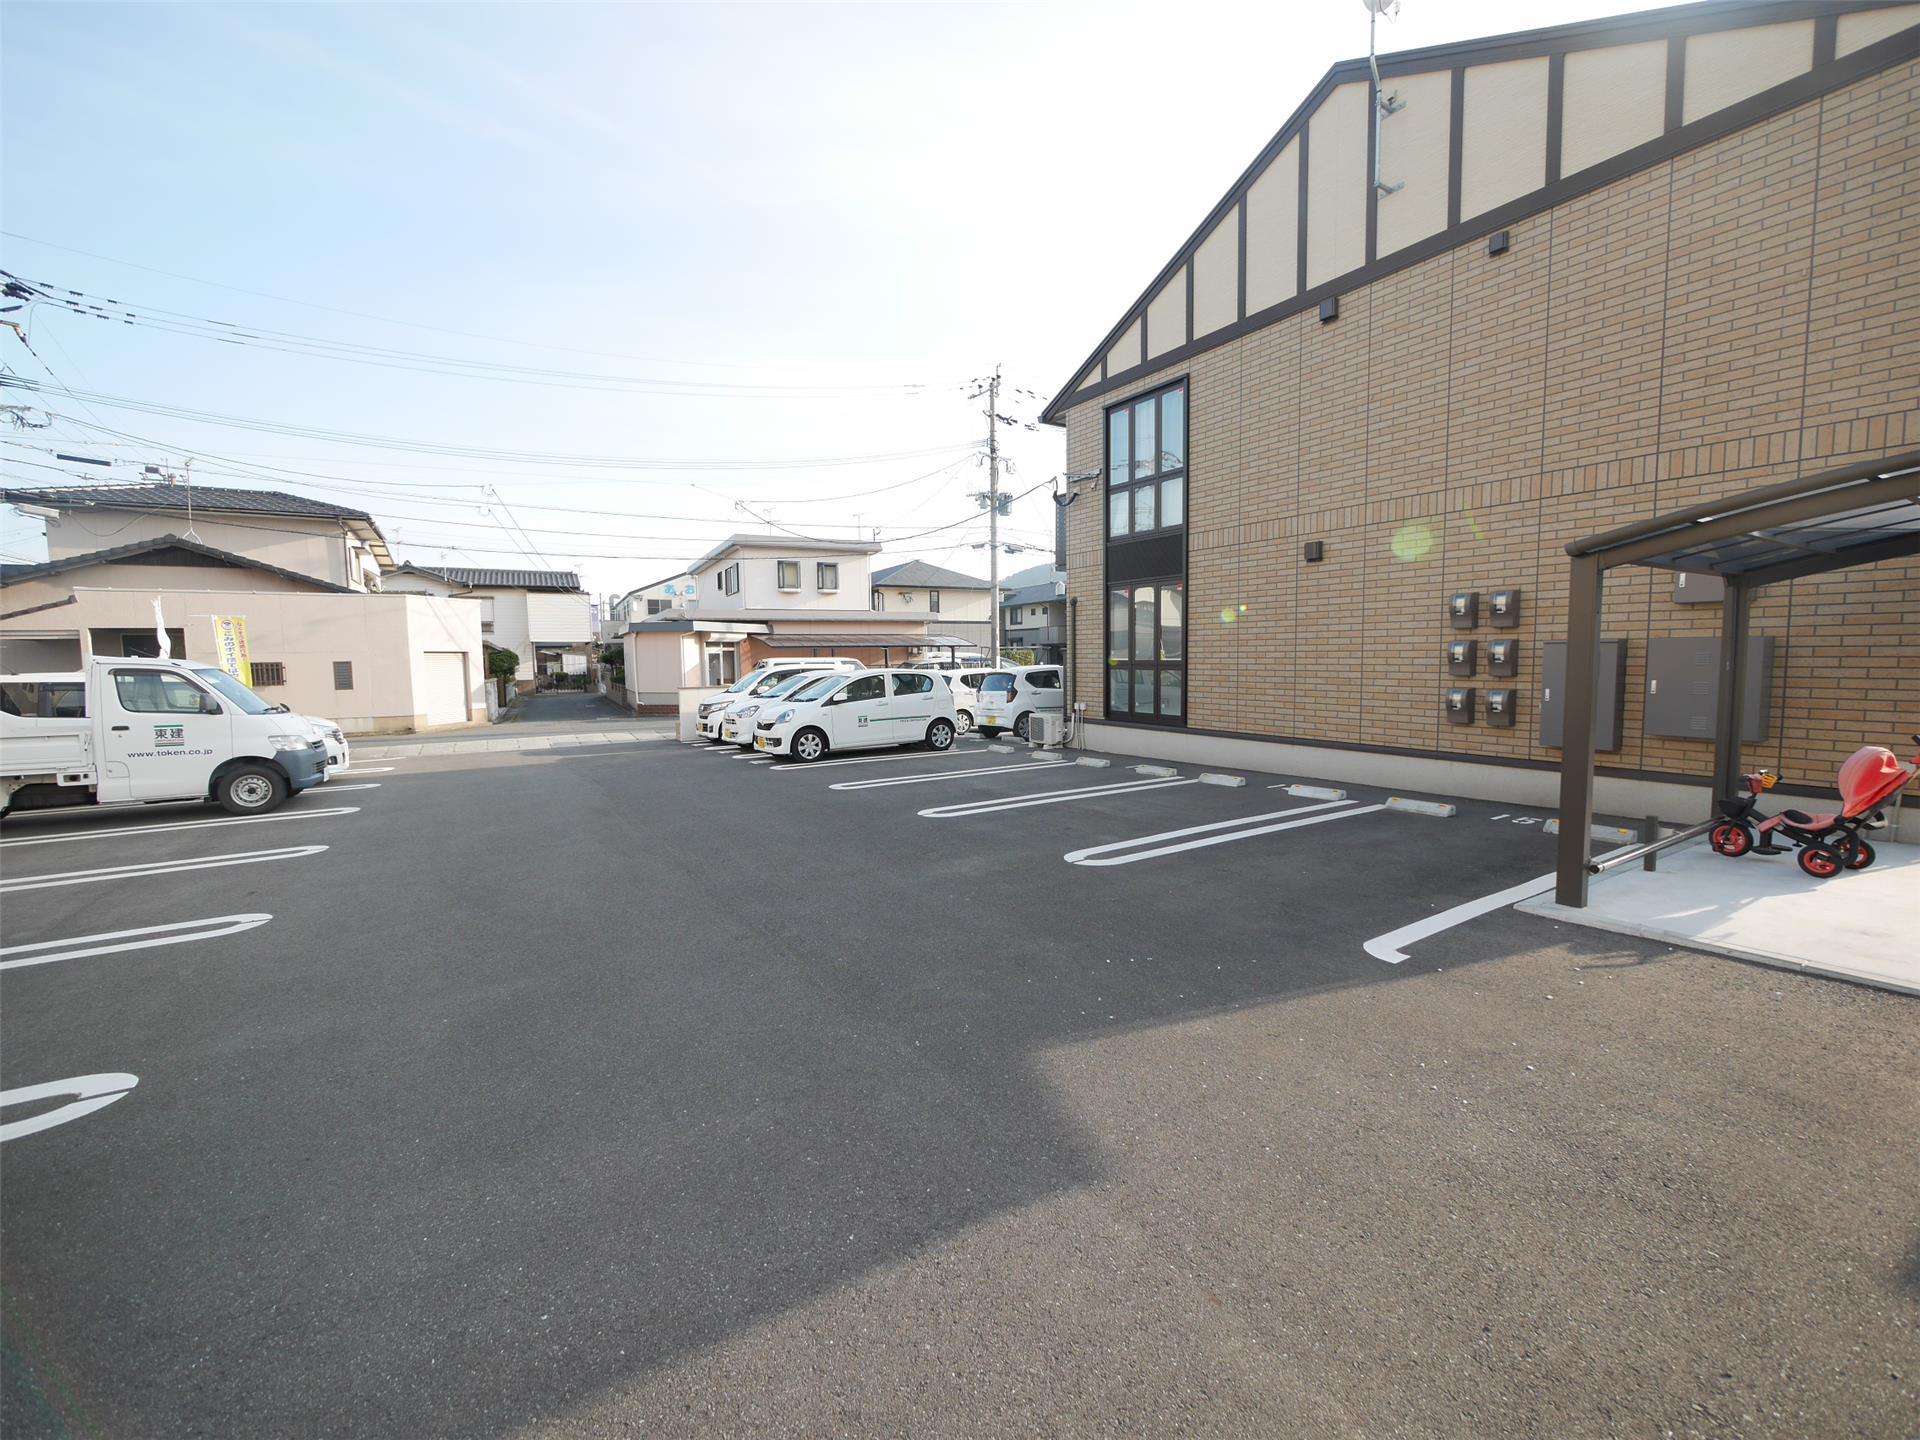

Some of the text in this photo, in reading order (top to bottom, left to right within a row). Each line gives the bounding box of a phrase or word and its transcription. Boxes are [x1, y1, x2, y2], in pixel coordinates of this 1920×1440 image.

[154, 728, 184, 739] 東建
[127, 749, 213, 758] www.token.co.jp
[1490, 814, 1543, 824] 15
